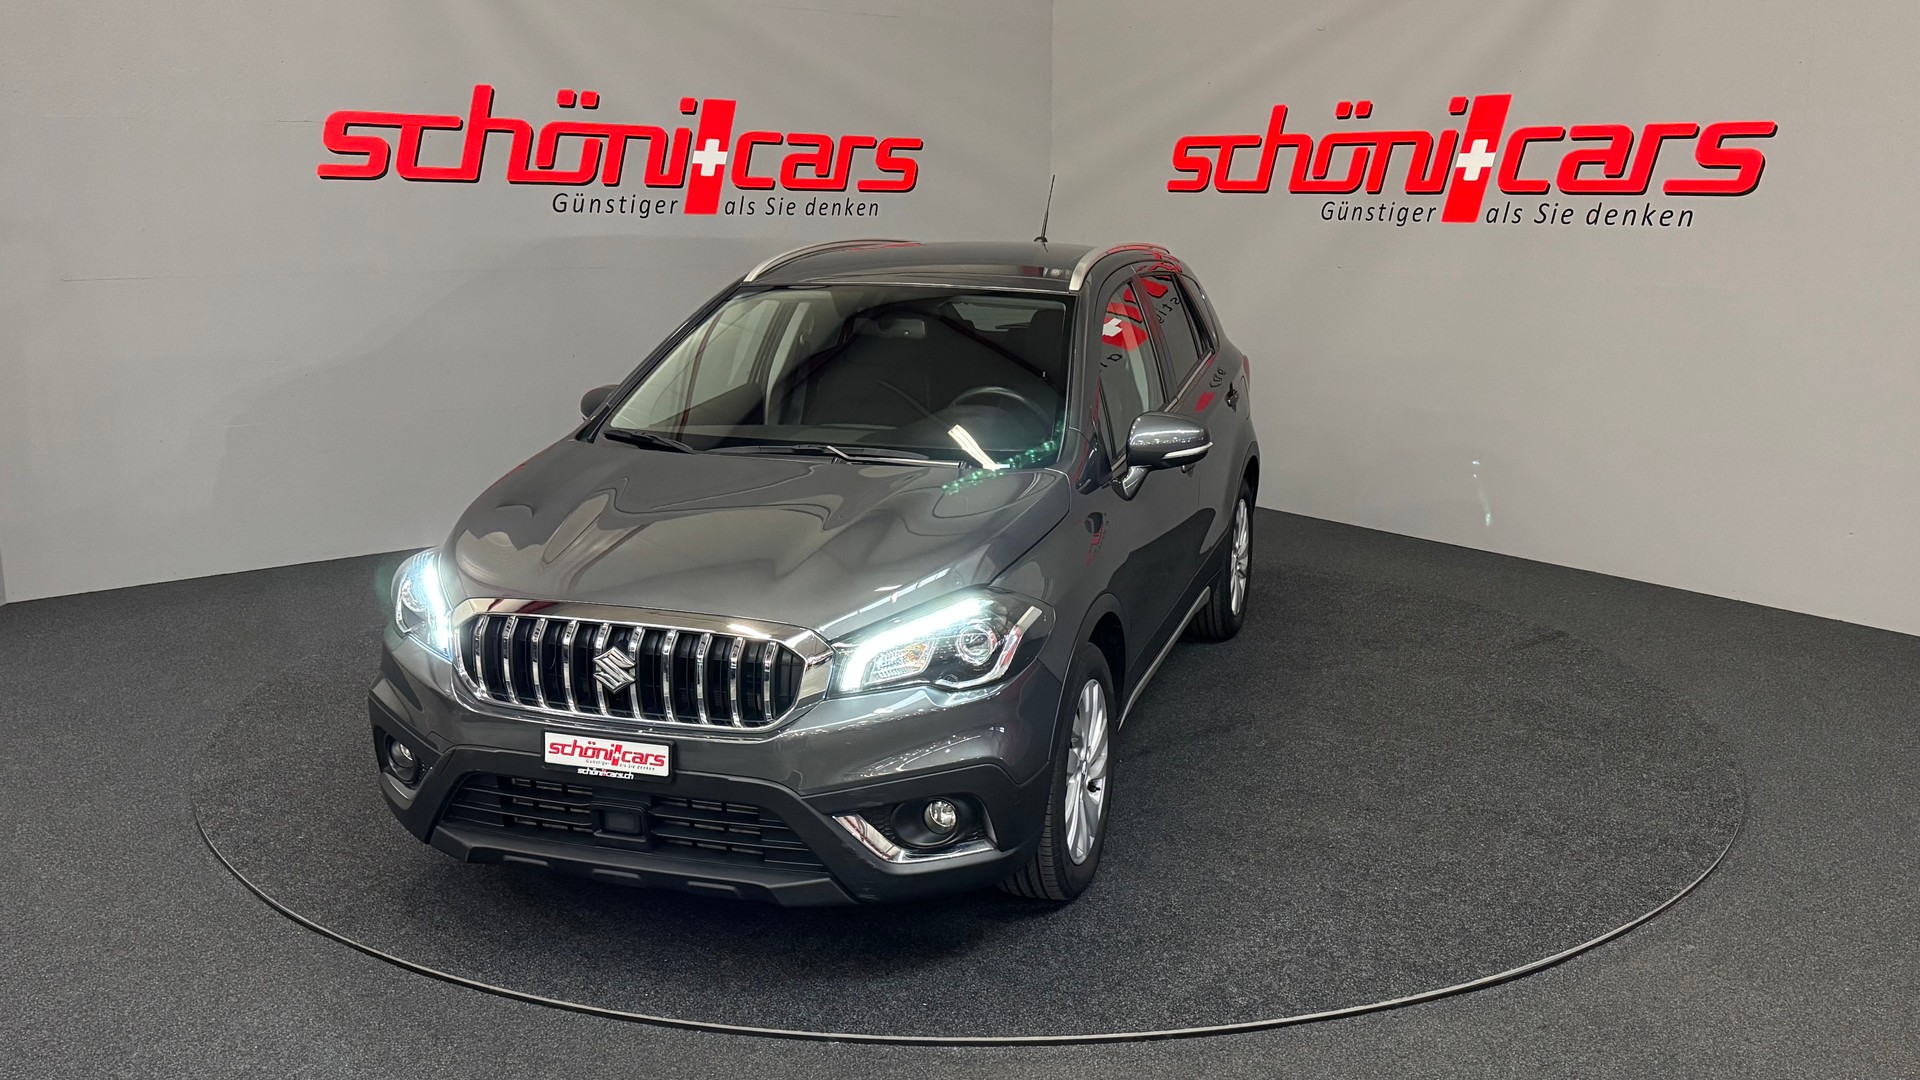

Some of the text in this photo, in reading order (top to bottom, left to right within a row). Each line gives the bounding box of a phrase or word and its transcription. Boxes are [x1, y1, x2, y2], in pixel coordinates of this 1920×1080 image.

[552, 192, 879, 219] Günstiger als Sie denken
[1320, 201, 1694, 227] Günstiger als Sie denken
